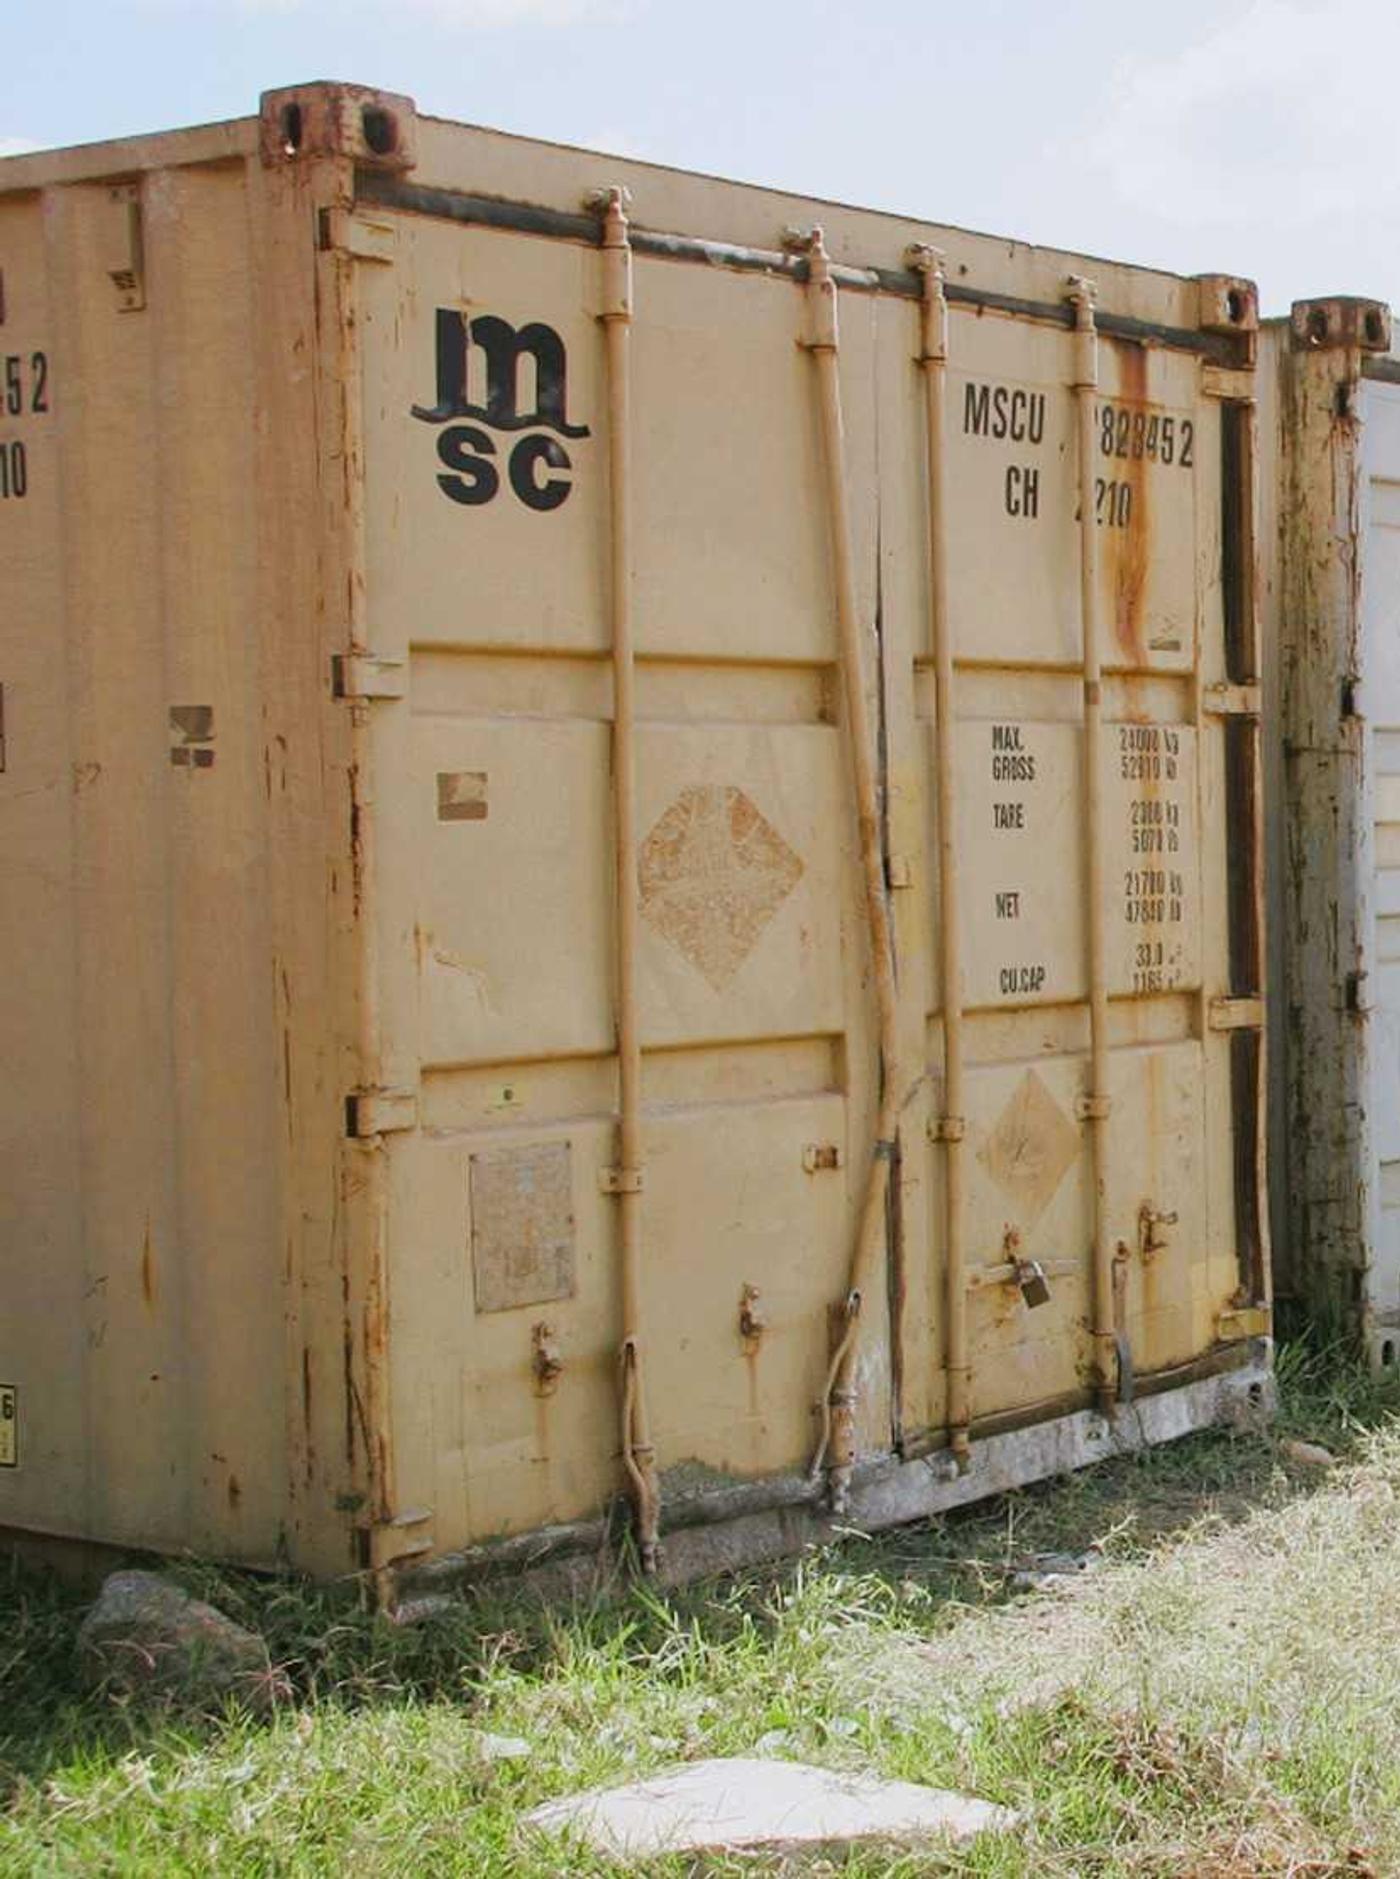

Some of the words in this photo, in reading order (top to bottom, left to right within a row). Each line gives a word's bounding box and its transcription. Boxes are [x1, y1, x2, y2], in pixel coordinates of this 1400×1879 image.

[0, 351, 49, 416] 52
[963, 382, 1045, 445] MSCU
[1094, 405, 1194, 468] 823452
[1005, 465, 1039, 519] CH
[992, 756, 1035, 781] GROSS
[993, 803, 1025, 829] TARE
[995, 893, 1020, 919] NET
